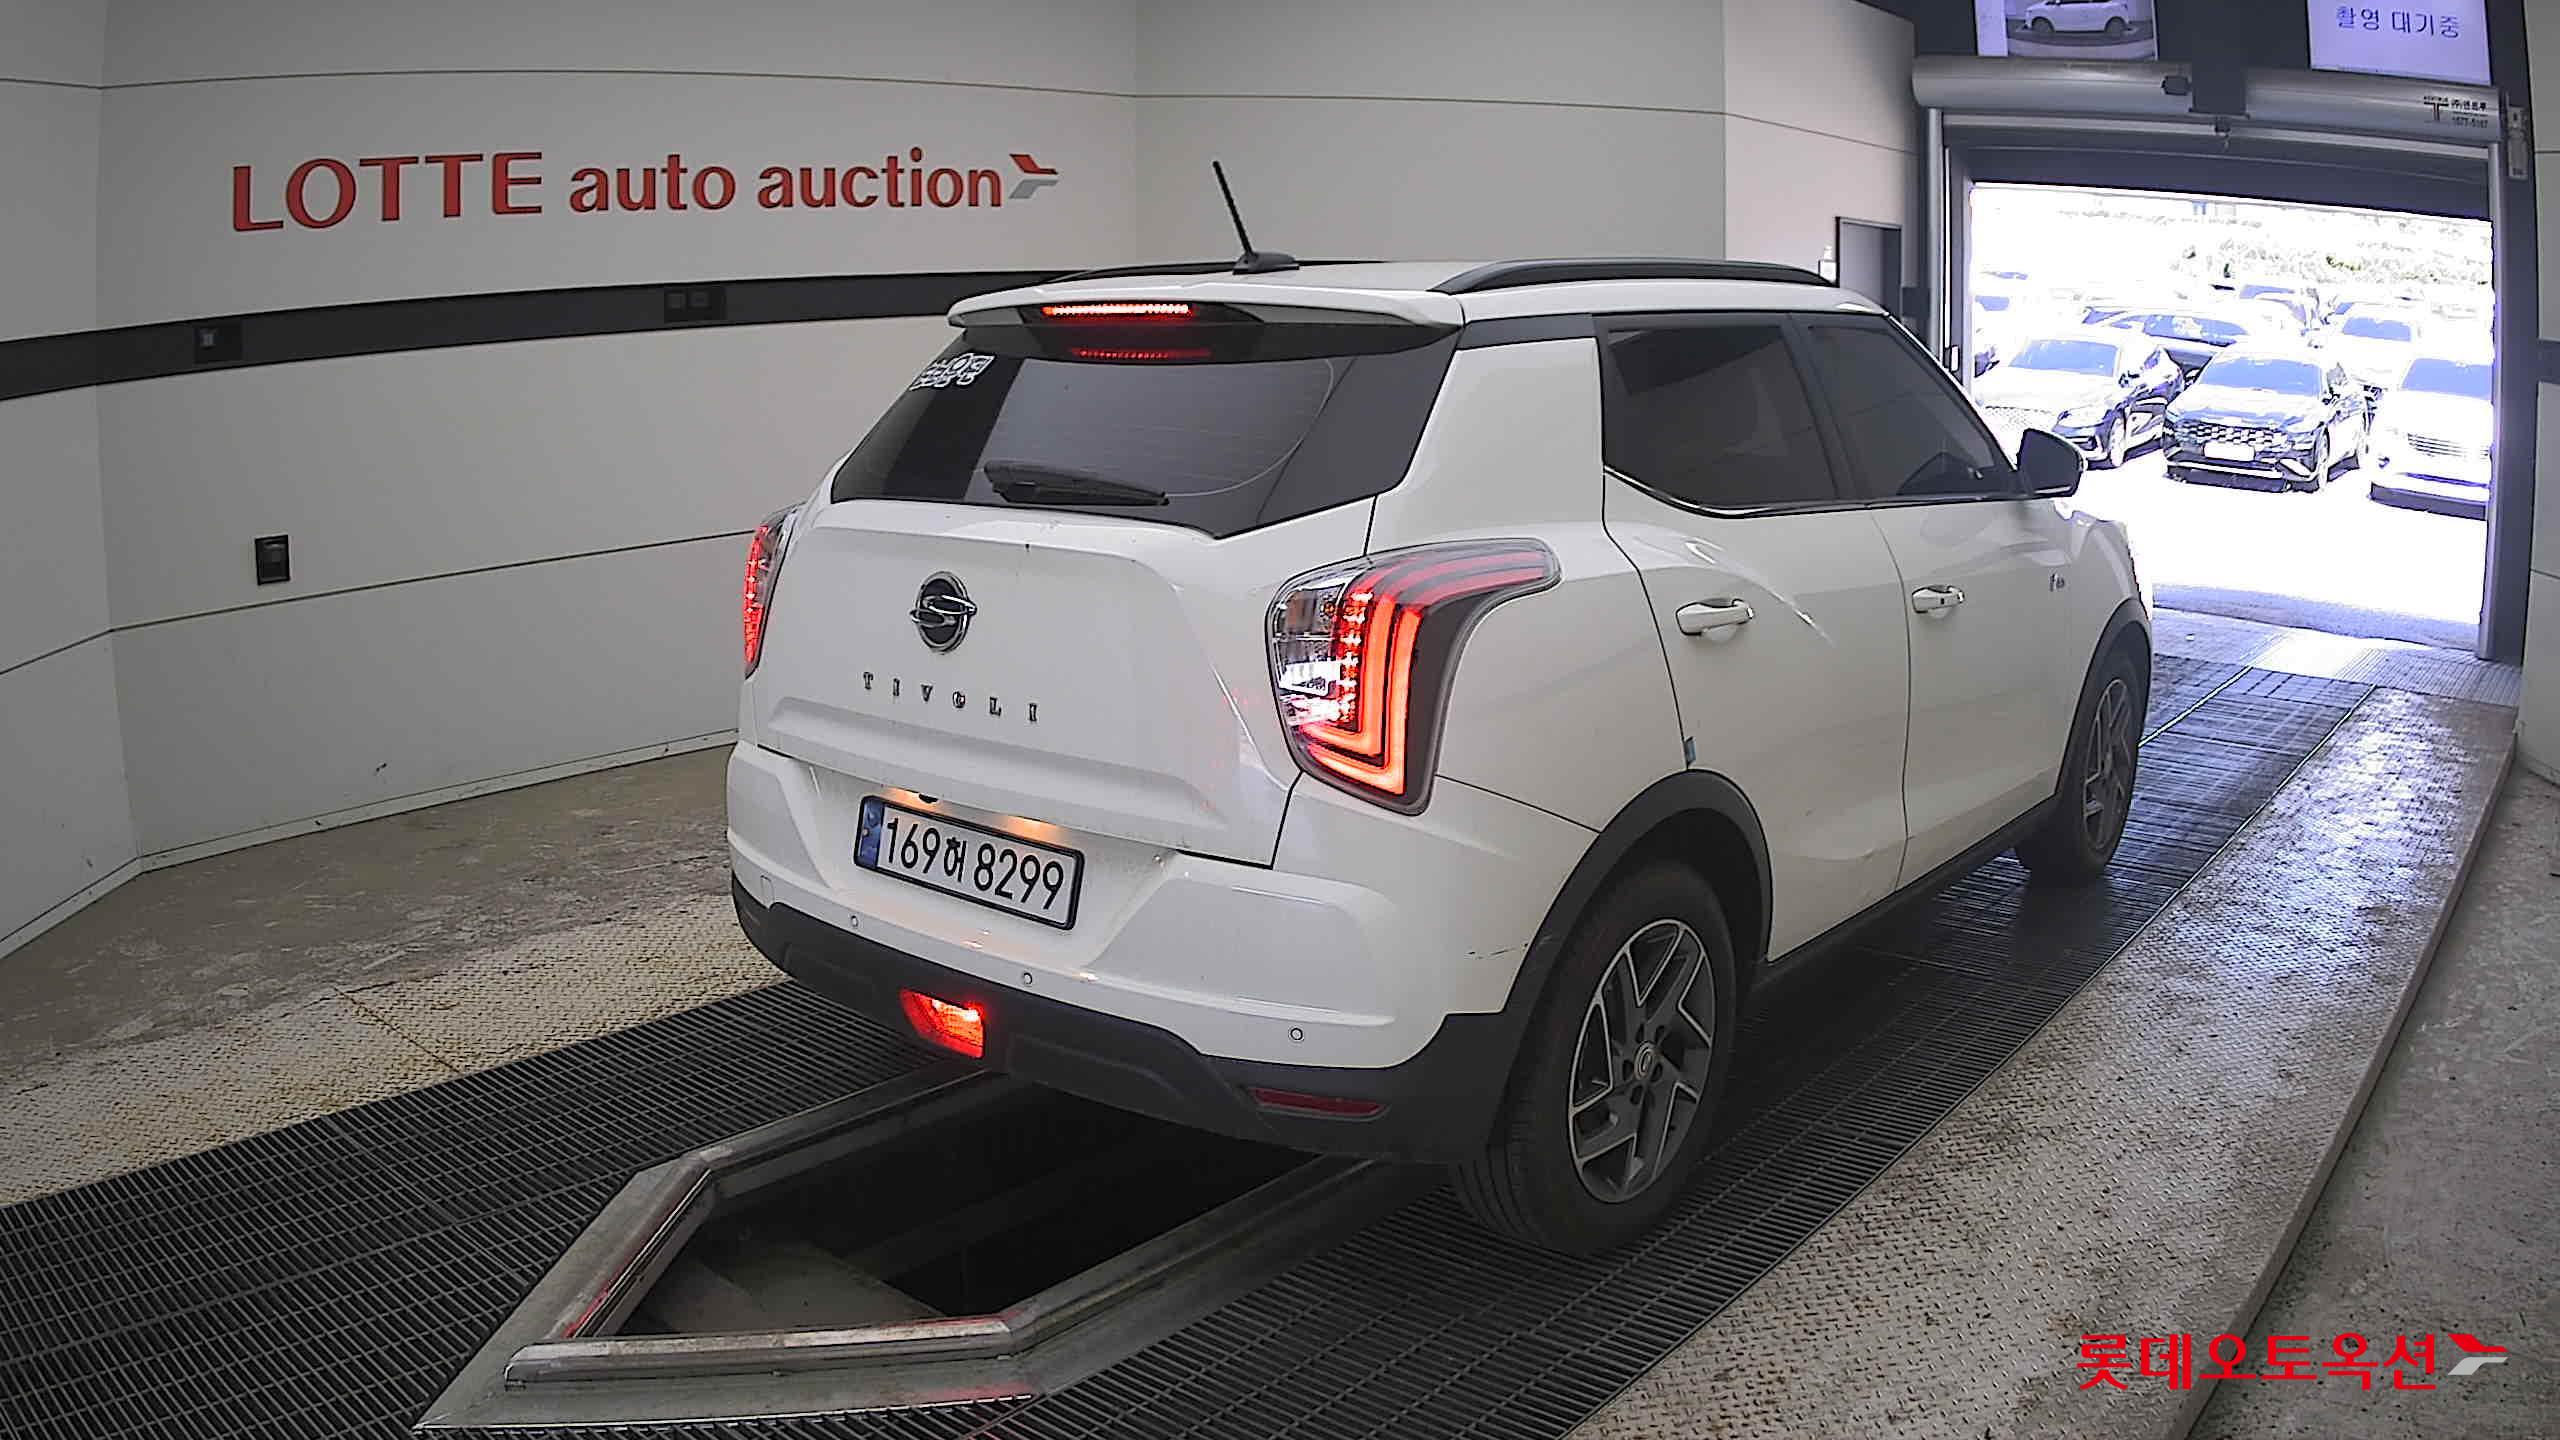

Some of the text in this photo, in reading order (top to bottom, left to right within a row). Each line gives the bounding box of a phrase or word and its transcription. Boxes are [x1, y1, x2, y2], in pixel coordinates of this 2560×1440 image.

[2336, 5, 2459, 38] 촬영 대기중
[233, 147, 1002, 233] LOTTE auto auction
[862, 671, 1038, 722] TIVOLI
[887, 816, 1064, 910] 169허 8299
